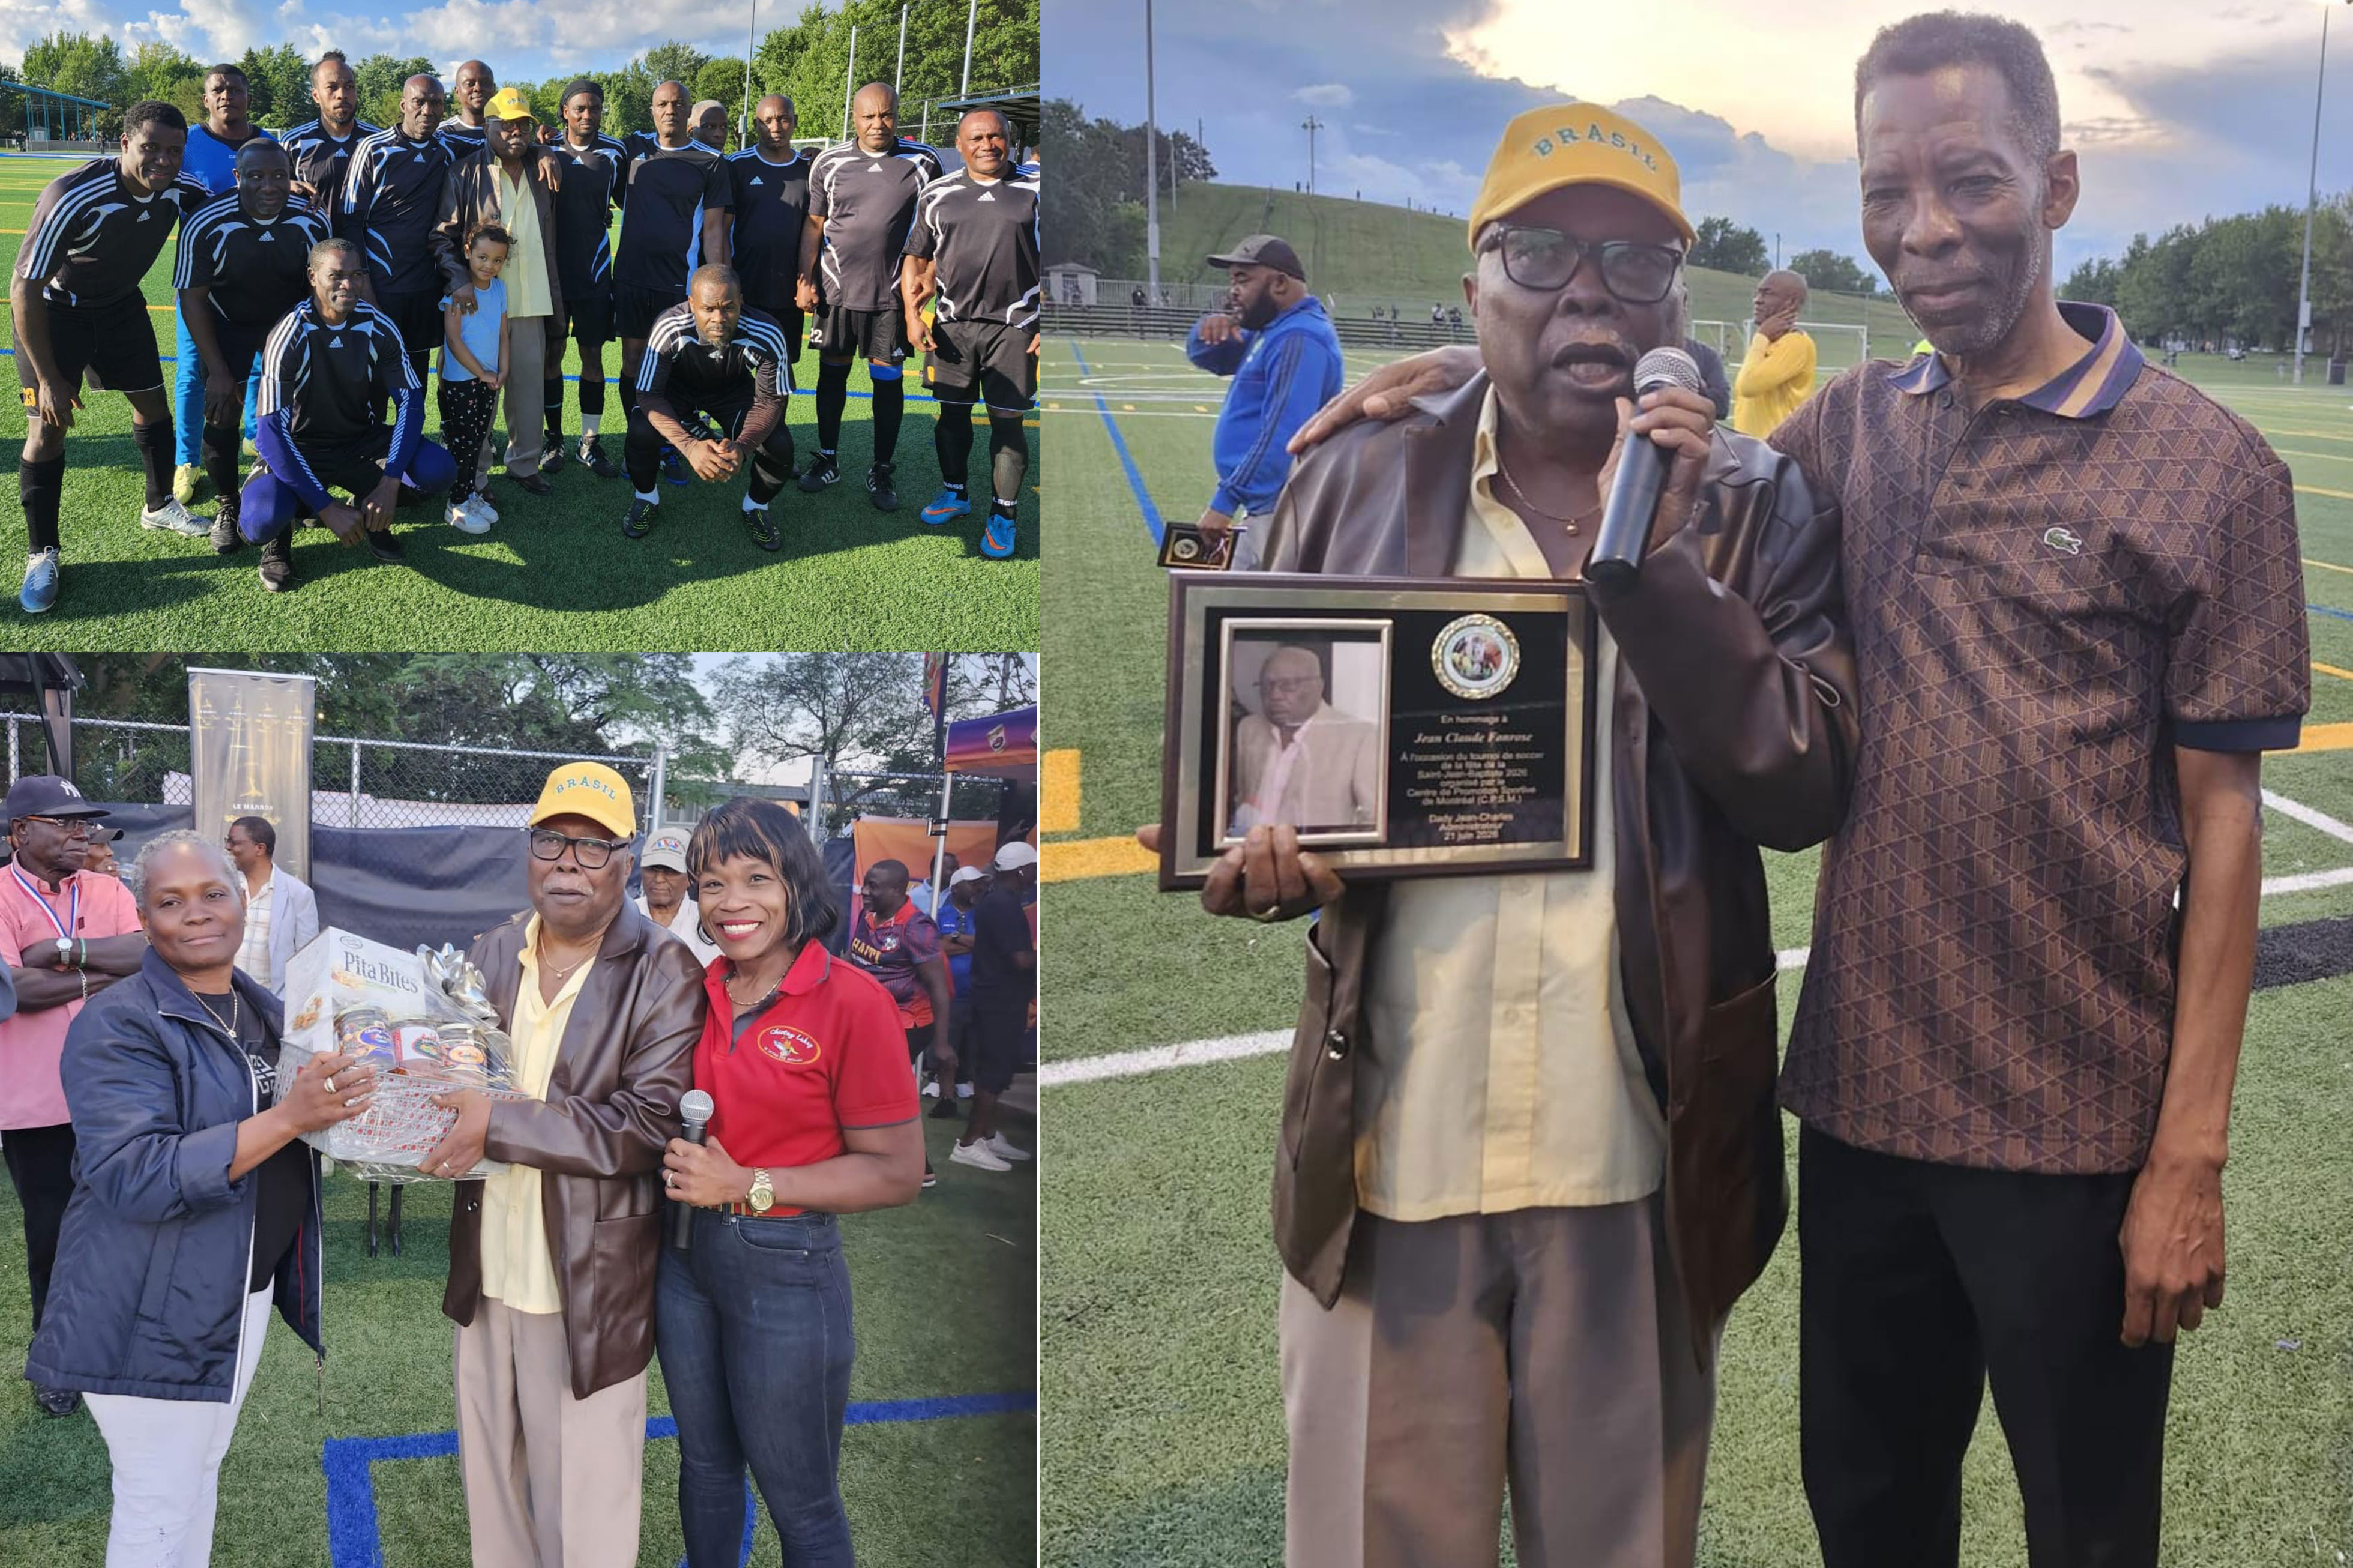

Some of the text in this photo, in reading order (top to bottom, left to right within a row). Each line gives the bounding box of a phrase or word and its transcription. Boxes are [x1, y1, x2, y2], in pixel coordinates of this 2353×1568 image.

[1534, 123, 1657, 172] BRASIL
[1441, 714, 1453, 723] En
[1456, 714, 1500, 725] hommage
[1414, 732, 1442, 744] Jean
[1445, 731, 1484, 743] Claude
[556, 775, 616, 800] BRASIL
[852, 938, 882, 965] HAITI
[344, 951, 418, 994] Pita Bites
